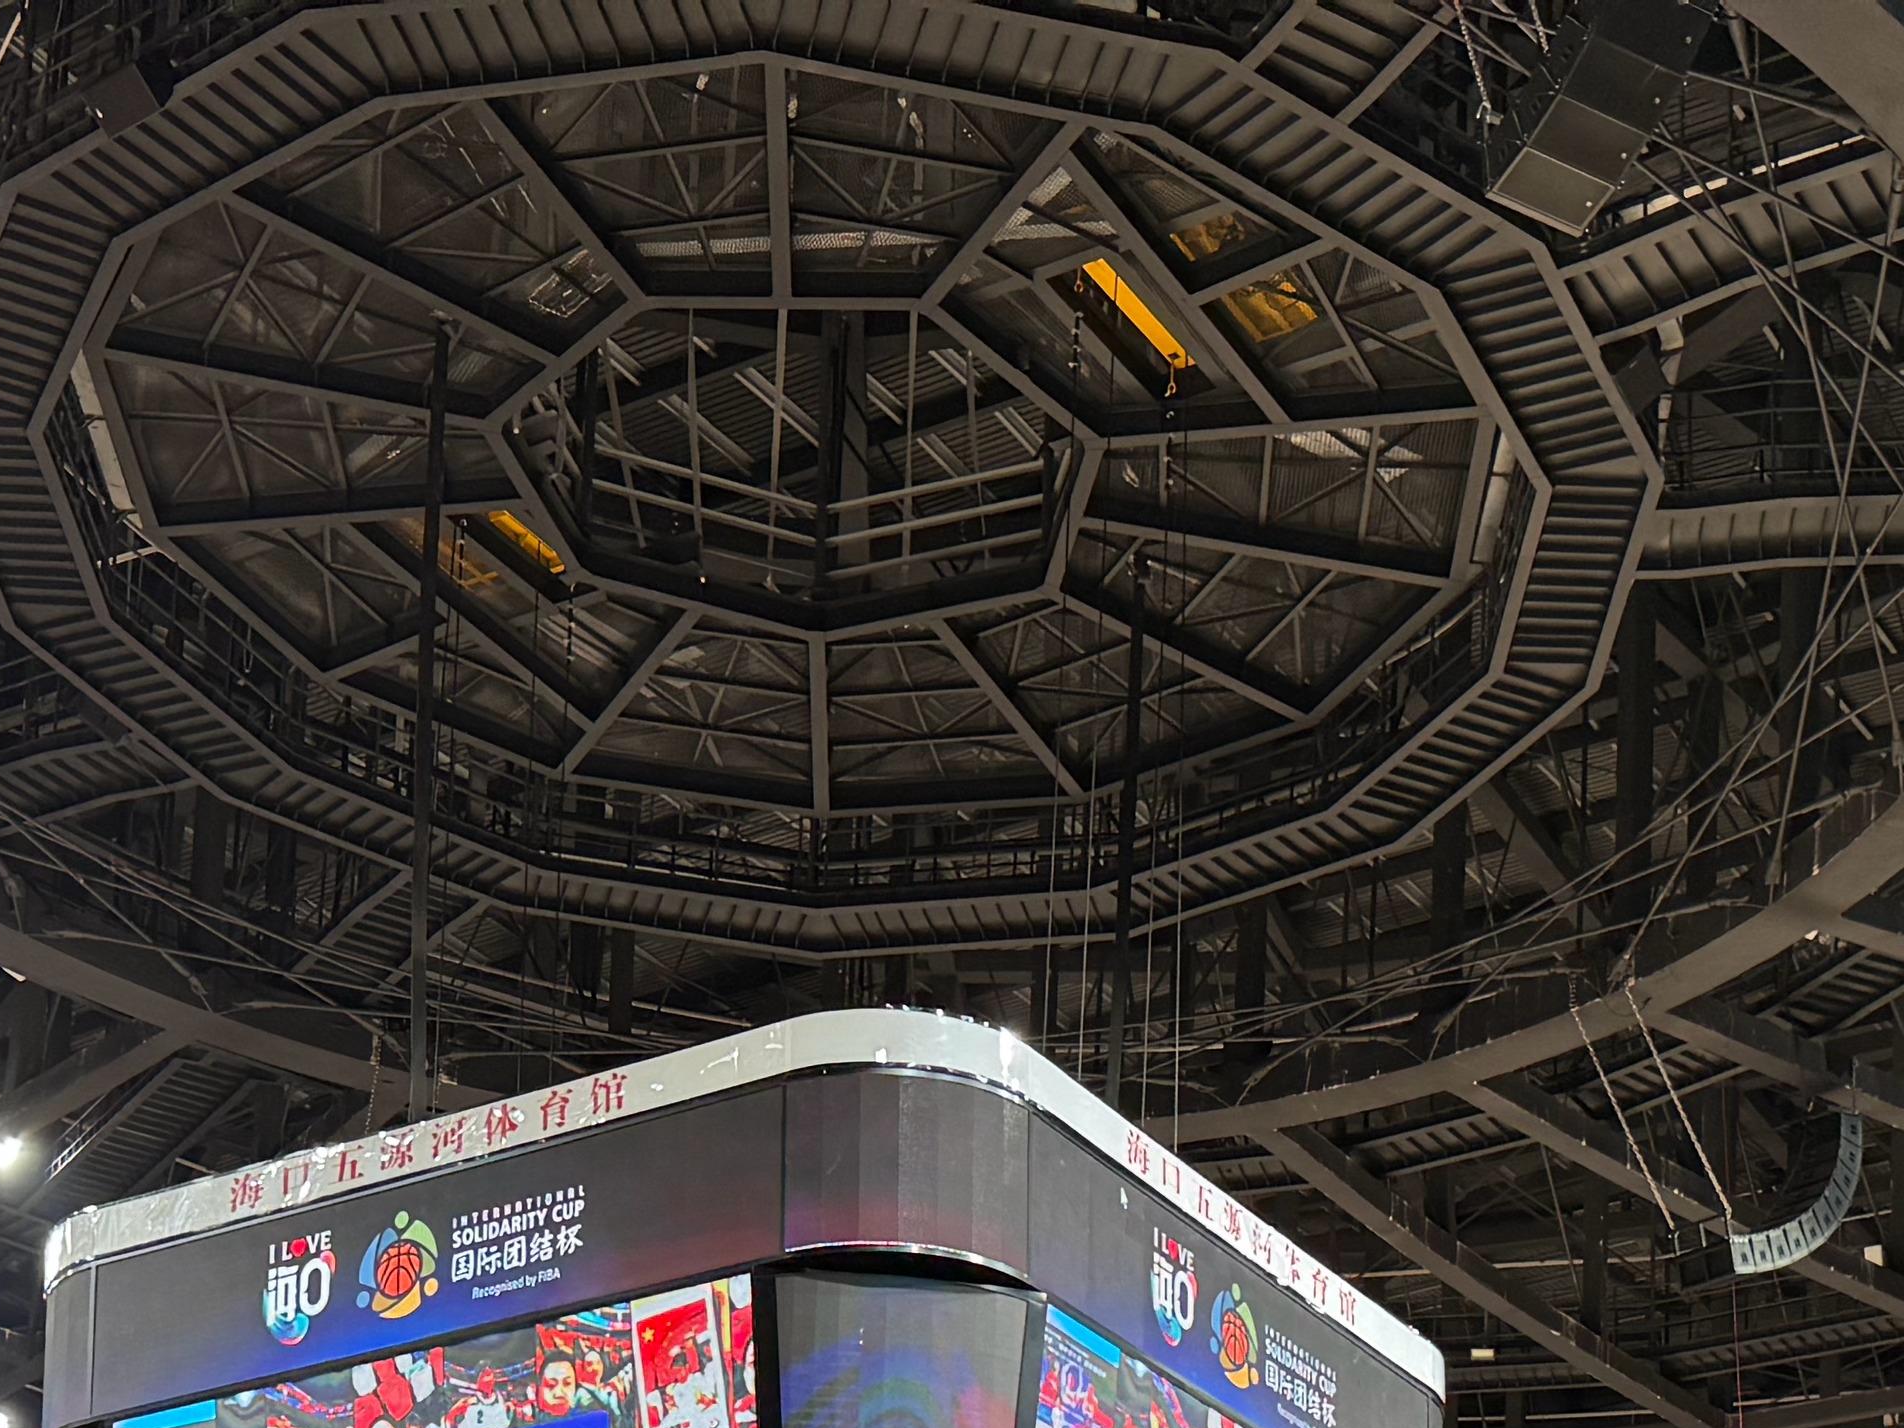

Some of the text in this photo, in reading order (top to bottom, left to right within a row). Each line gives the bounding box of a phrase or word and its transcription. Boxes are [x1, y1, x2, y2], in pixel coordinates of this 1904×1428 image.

[230, 1073, 628, 1212] 海口五源河体育馆
[451, 1224, 584, 1282] 国际团结杯
[452, 1199, 585, 1248] SOLIDARITY CUP
[1265, 1361, 1336, 1428] 国际团结杯
